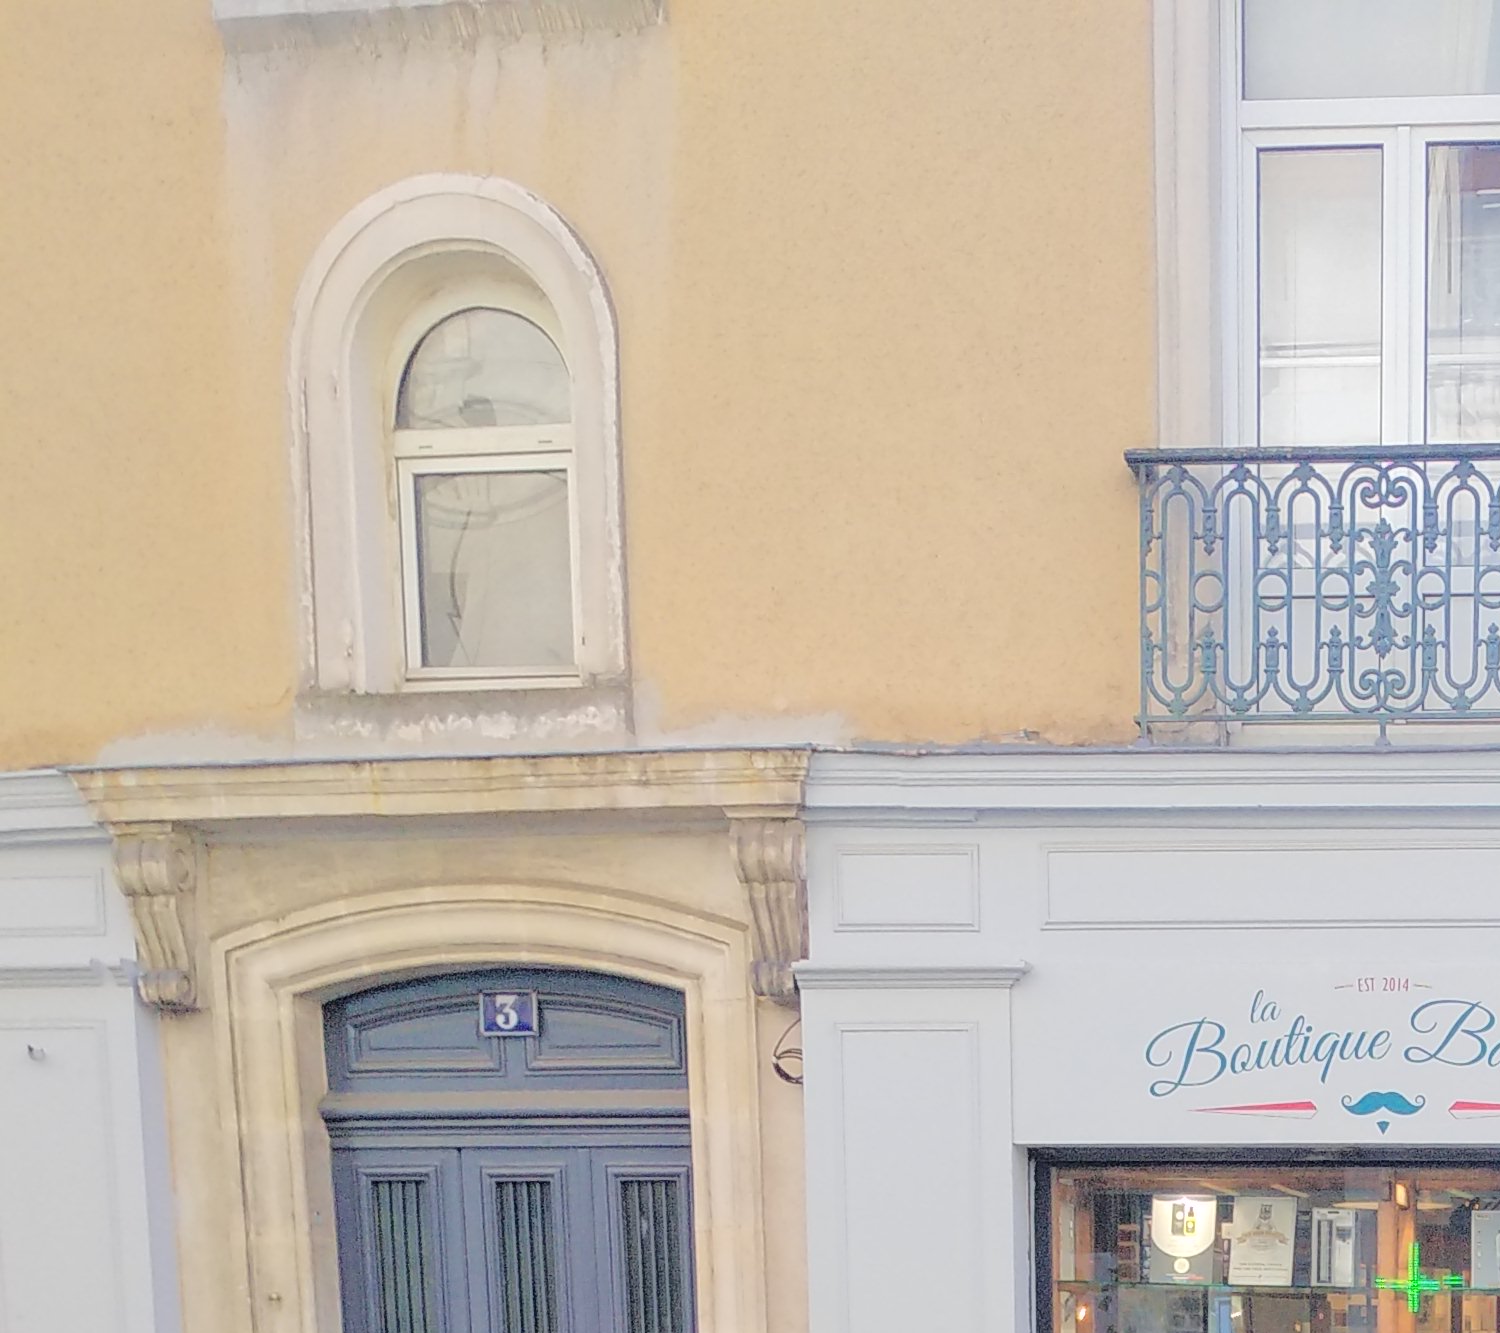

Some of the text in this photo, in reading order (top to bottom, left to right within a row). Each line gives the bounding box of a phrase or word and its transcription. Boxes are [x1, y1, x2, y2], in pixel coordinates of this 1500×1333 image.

[1357, 977, 1410, 992] EST 2014
[495, 994, 518, 1029] 3
[1249, 989, 1281, 1023] la
[1145, 1014, 1392, 1097] Boutique
